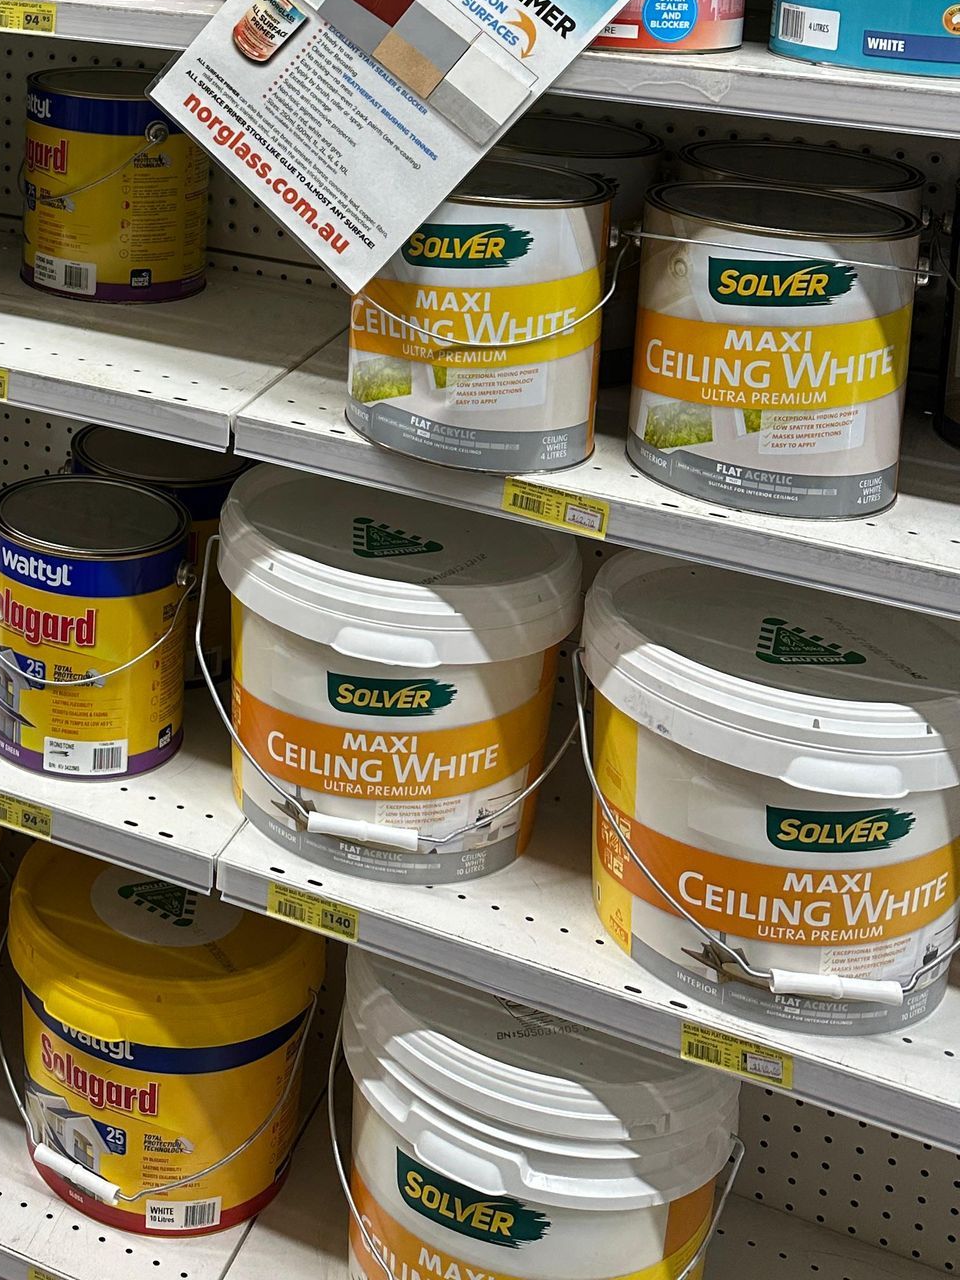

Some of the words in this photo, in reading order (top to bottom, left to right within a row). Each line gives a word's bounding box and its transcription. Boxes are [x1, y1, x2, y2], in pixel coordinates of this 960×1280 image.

[655, 2, 688, 13] SEALER
[661, 11, 678, 21] AND
[650, 19, 690, 31] BLOCKER
[867, 36, 905, 53] WHITE
[358, 51, 377, 70] STAIN
[374, 66, 398, 89] SEALER
[399, 89, 429, 116] BLOCKER
[182, 93, 351, 255] norglass.com.au
[408, 230, 506, 261] SOLVER
[717, 269, 829, 297] SOLVER
[415, 289, 492, 313] MAXI
[724, 328, 813, 353] MAXI
[471, 381, 495, 389] SPATTER
[772, 424, 787, 432] LOW
[788, 423, 815, 431] SPATTER
[815, 419, 855, 429] TECHNOLOGY
[773, 415, 816, 423] EXCEPTIONAL
[816, 412, 839, 421] HIDING
[839, 410, 860, 419] POWER
[542, 433, 568, 444] CEILING
[546, 442, 569, 452] WHITE
[859, 476, 883, 488] CEILING
[2, 545, 71, 587] wattyl
[335, 682, 432, 710] SOLVER
[342, 733, 418, 754] MAXI
[776, 817, 890, 846] SOLVER
[782, 872, 872, 896] MAXI
[323, 910, 352, 930] $140
[40, 1031, 160, 1116] Solagard
[150, 1206, 174, 1217] WHITE
[404, 1170, 515, 1238] SOLVER
